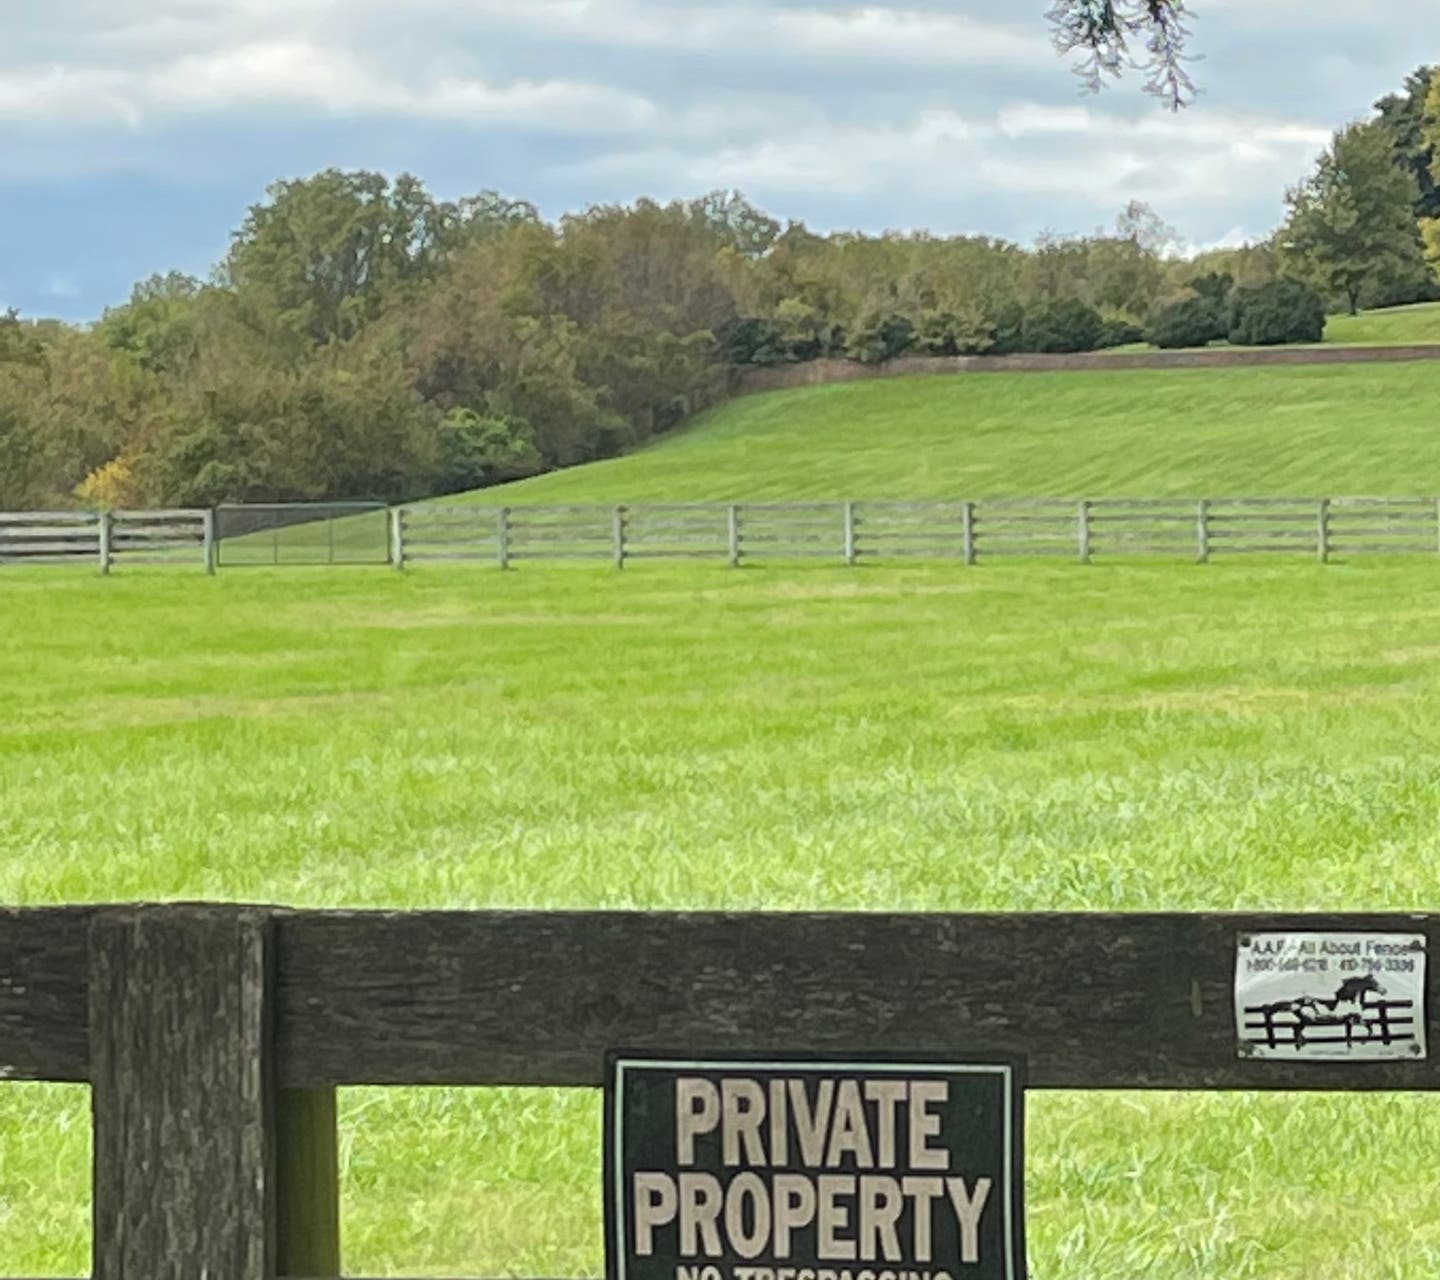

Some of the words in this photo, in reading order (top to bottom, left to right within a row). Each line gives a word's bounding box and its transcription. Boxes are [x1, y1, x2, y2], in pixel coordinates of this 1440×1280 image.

[1298, 939, 1316, 955] All
[1319, 940, 1361, 956] About
[675, 1076, 950, 1170] PRIVATE
[632, 1170, 992, 1264] PROPERTY
